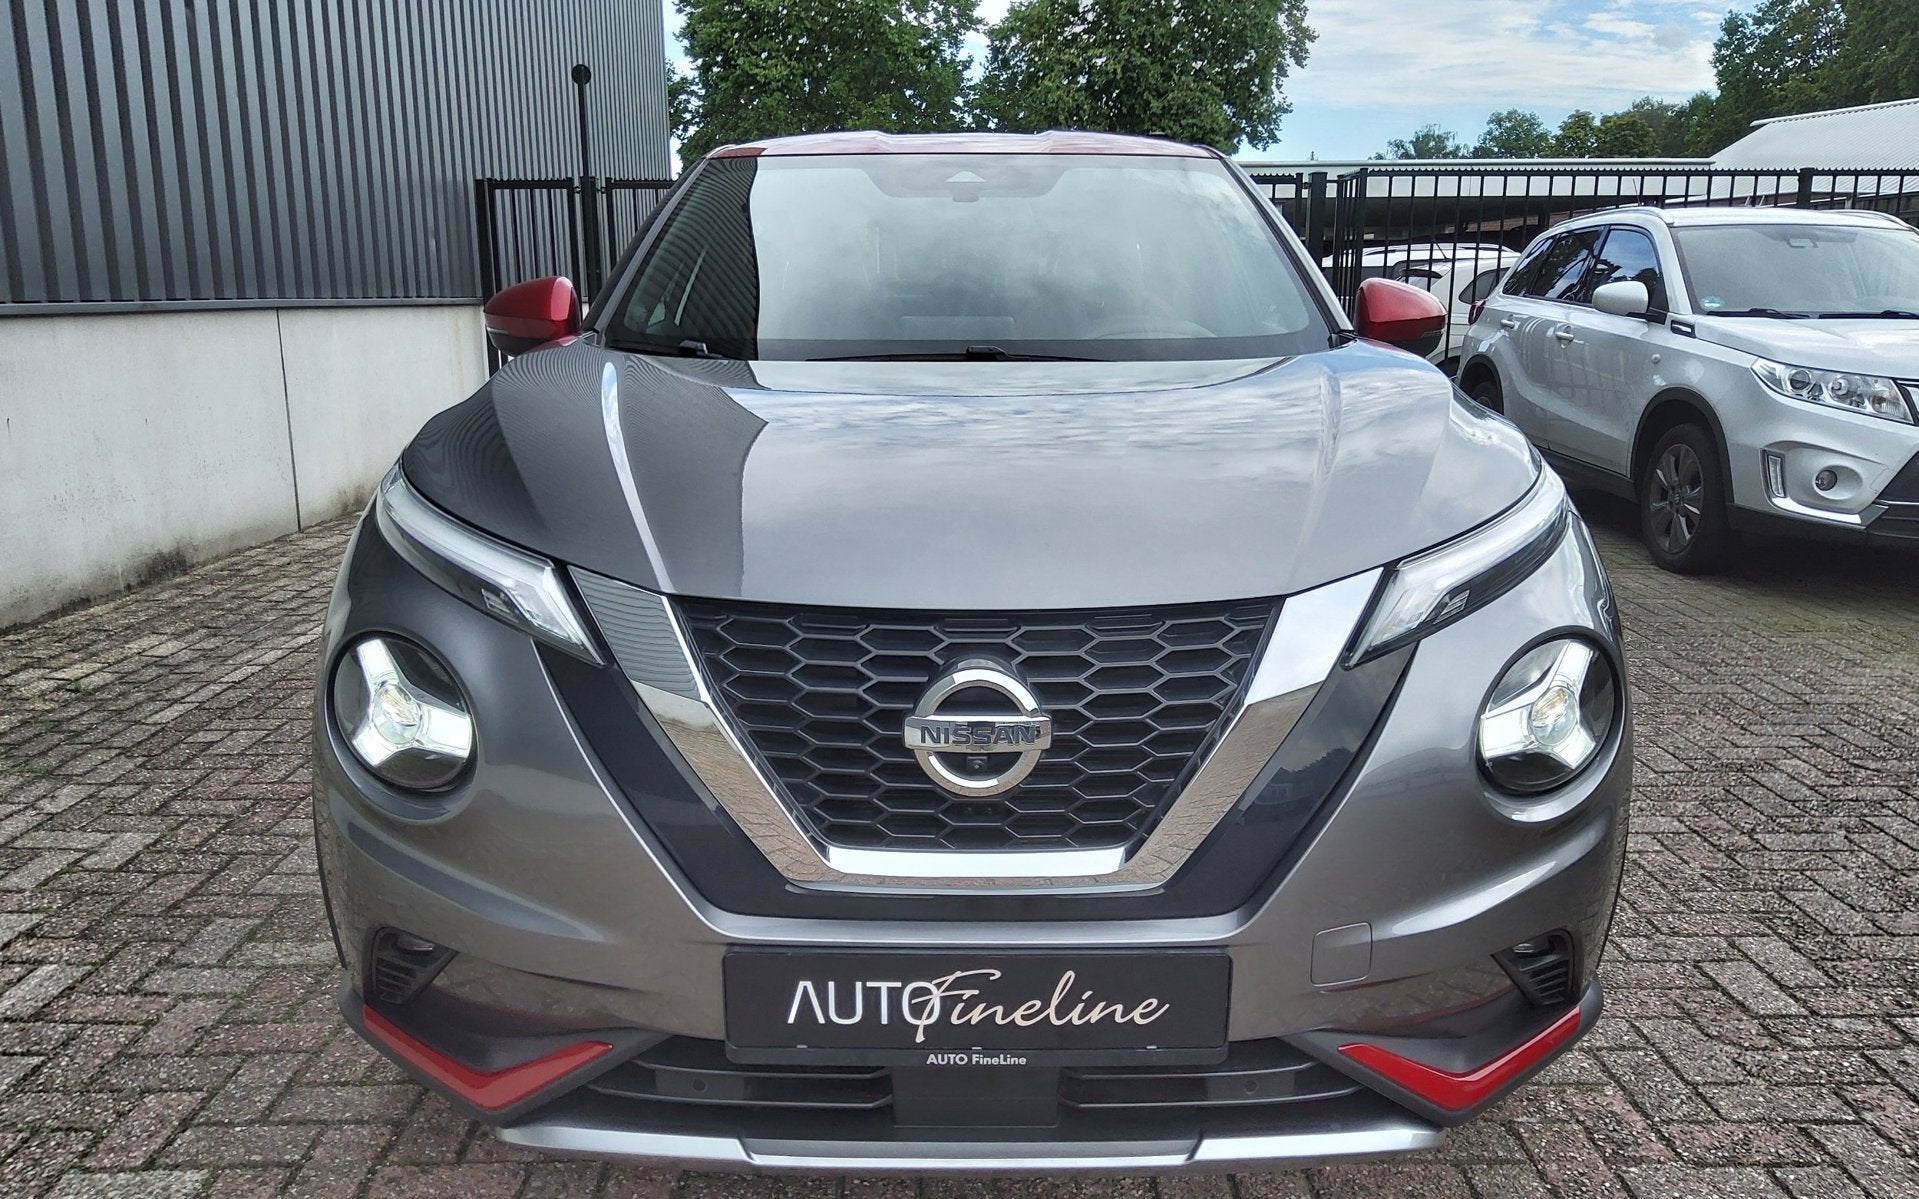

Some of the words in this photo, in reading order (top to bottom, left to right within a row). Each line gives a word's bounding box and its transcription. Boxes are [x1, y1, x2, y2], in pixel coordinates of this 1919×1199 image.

[920, 724, 1036, 745] NISSAN
[787, 980, 942, 1026] AUTO
[911, 968, 1170, 1044] Fineline
[926, 1053, 969, 1065] AUTO
[971, 1053, 1027, 1065] FineLine
